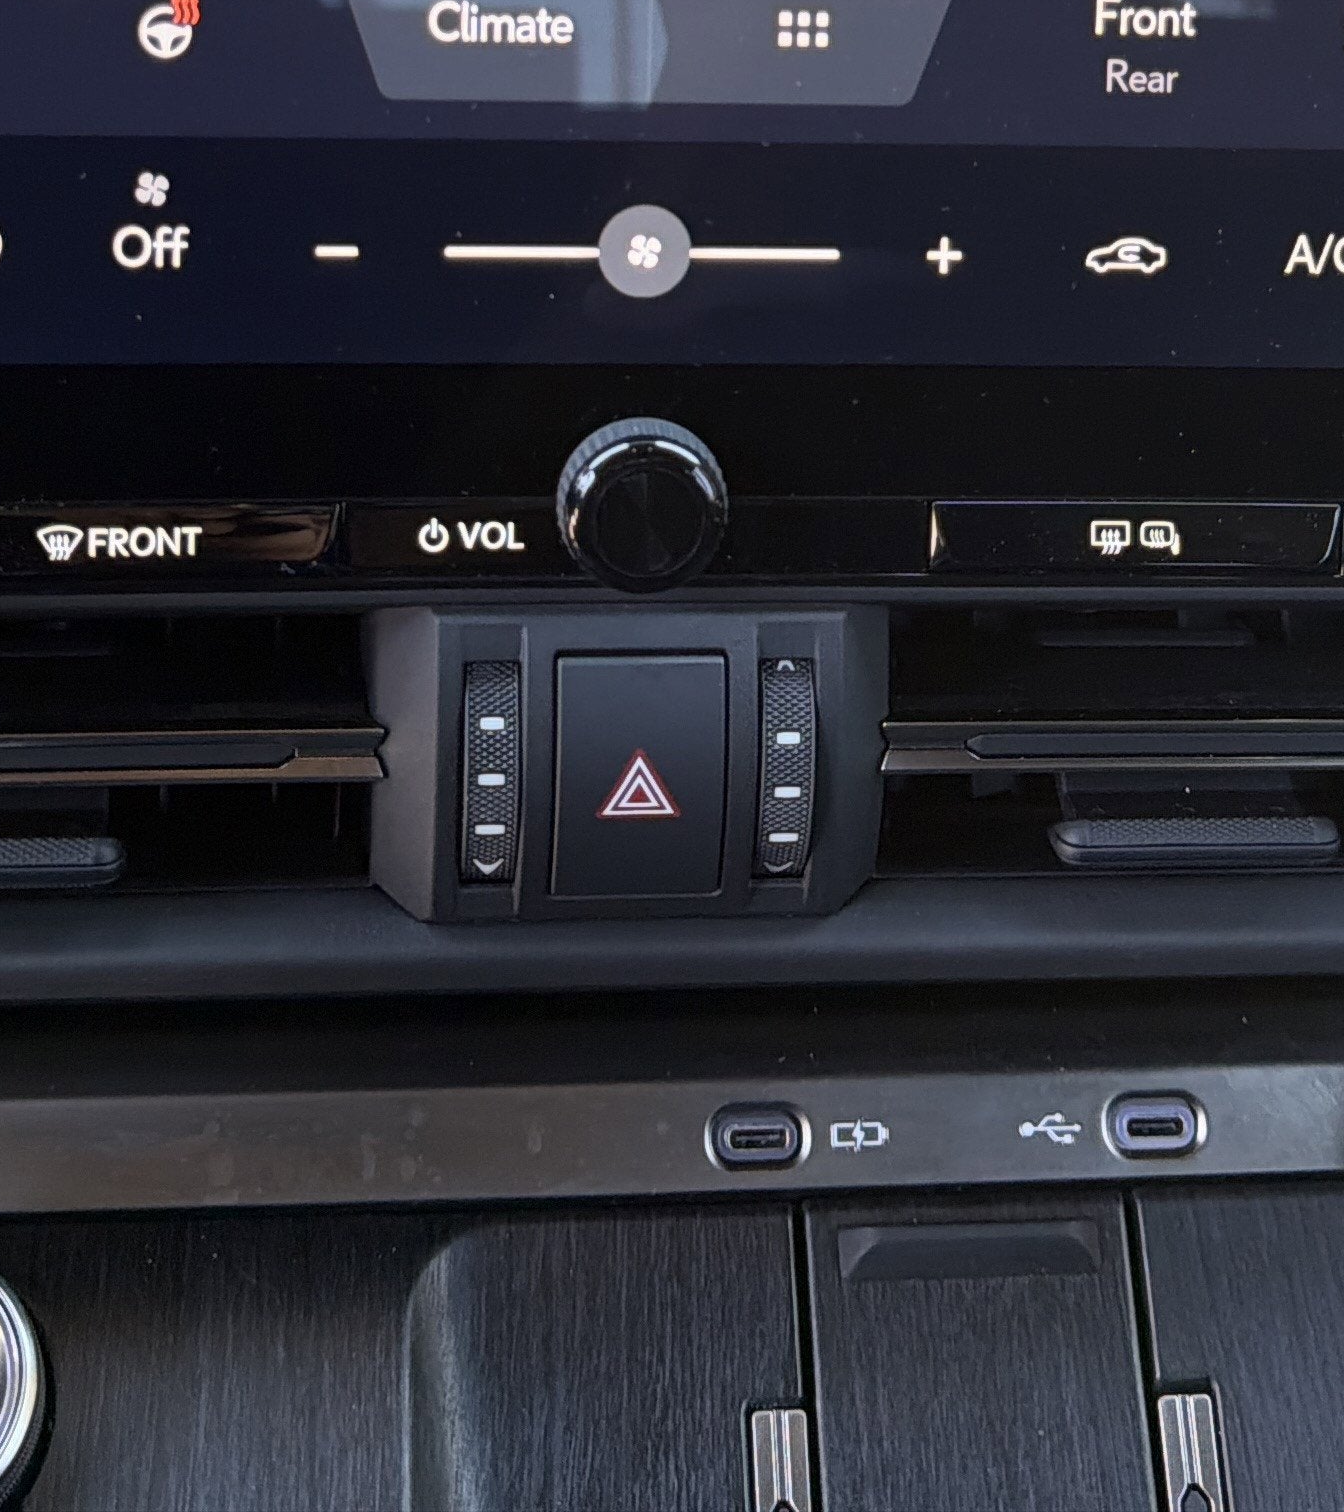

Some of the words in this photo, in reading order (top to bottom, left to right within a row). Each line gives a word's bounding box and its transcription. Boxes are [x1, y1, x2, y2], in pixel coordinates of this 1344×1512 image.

[1105, 58, 1180, 94] Rear
[112, 225, 191, 269] Off
[87, 526, 203, 558] FRONT
[457, 521, 525, 550] VOL
